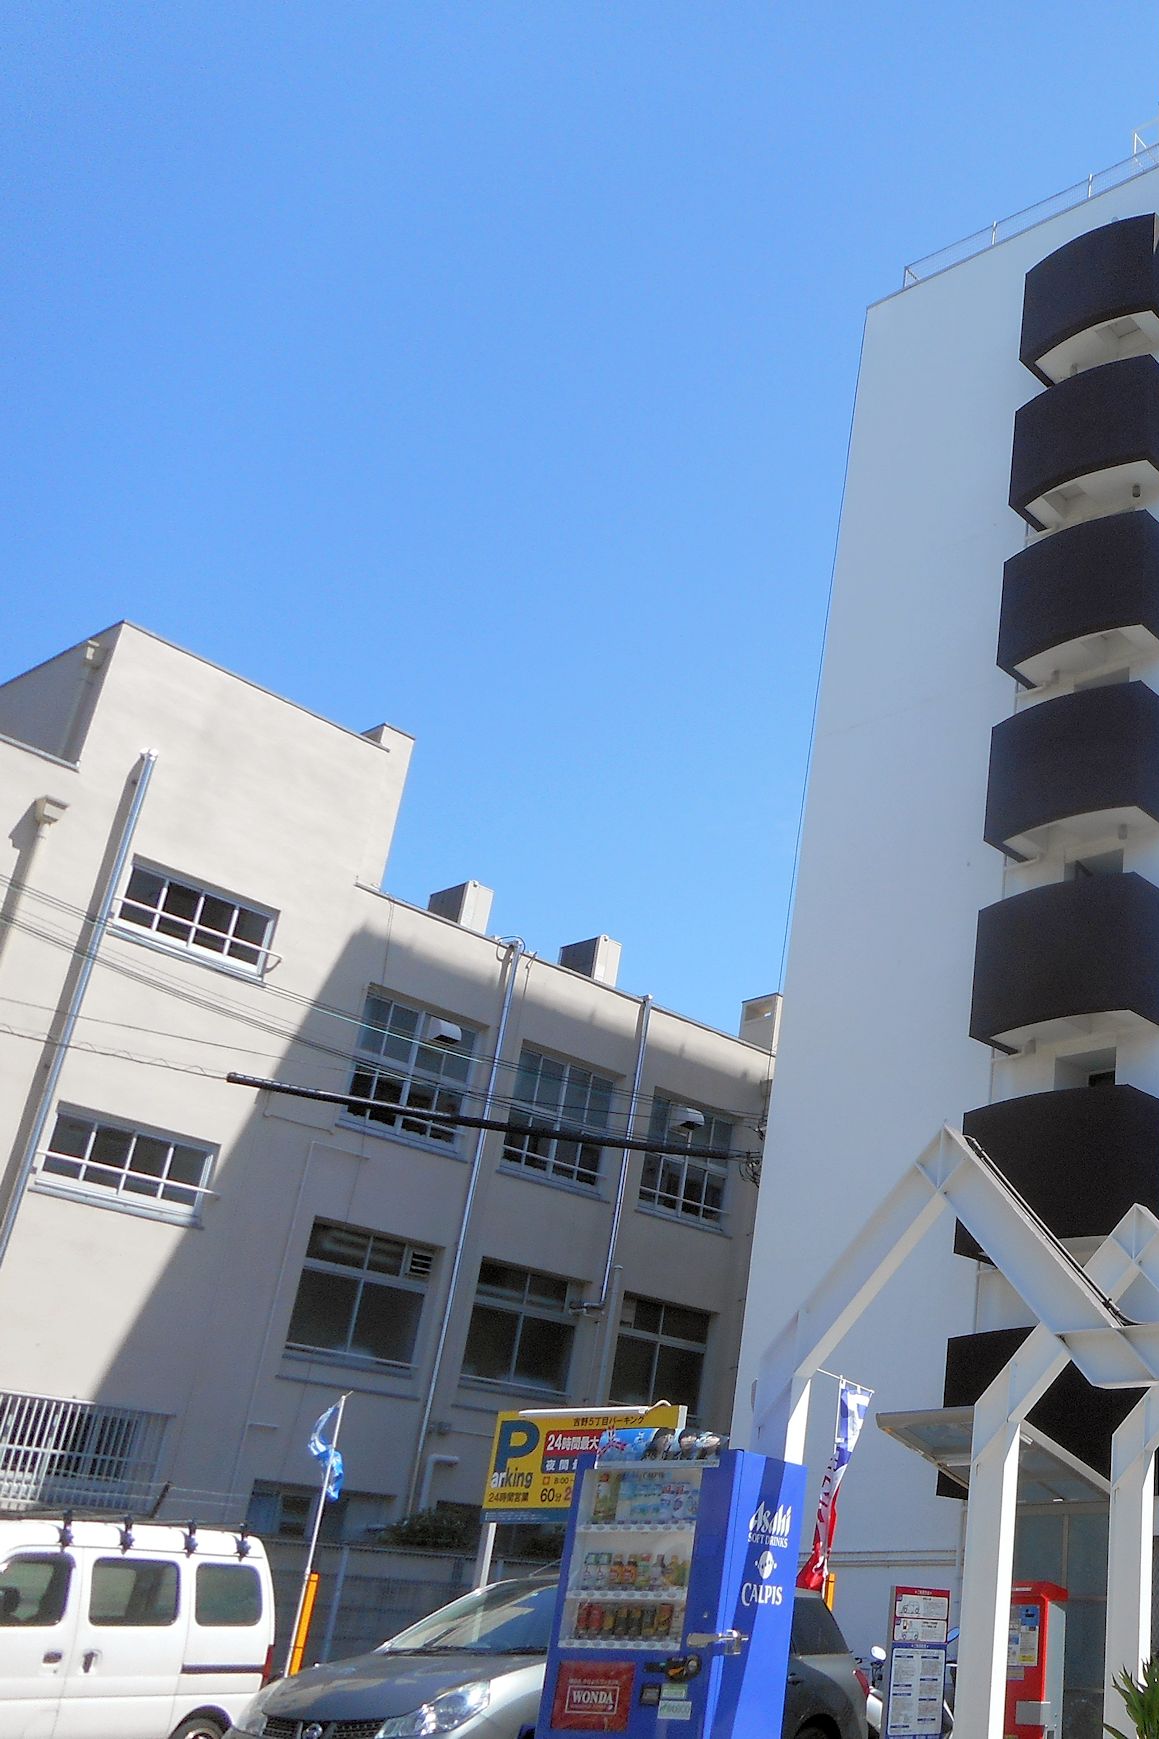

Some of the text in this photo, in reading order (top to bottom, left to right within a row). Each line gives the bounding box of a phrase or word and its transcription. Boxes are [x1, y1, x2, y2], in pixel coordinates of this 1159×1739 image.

[488, 1491, 529, 1503] 24時間営業
[749, 1501, 792, 1537] Asahi
[748, 1532, 789, 1549] SOFT DRINKS
[741, 1582, 783, 1606] CALPIS
[572, 1690, 614, 1704] WONDA
